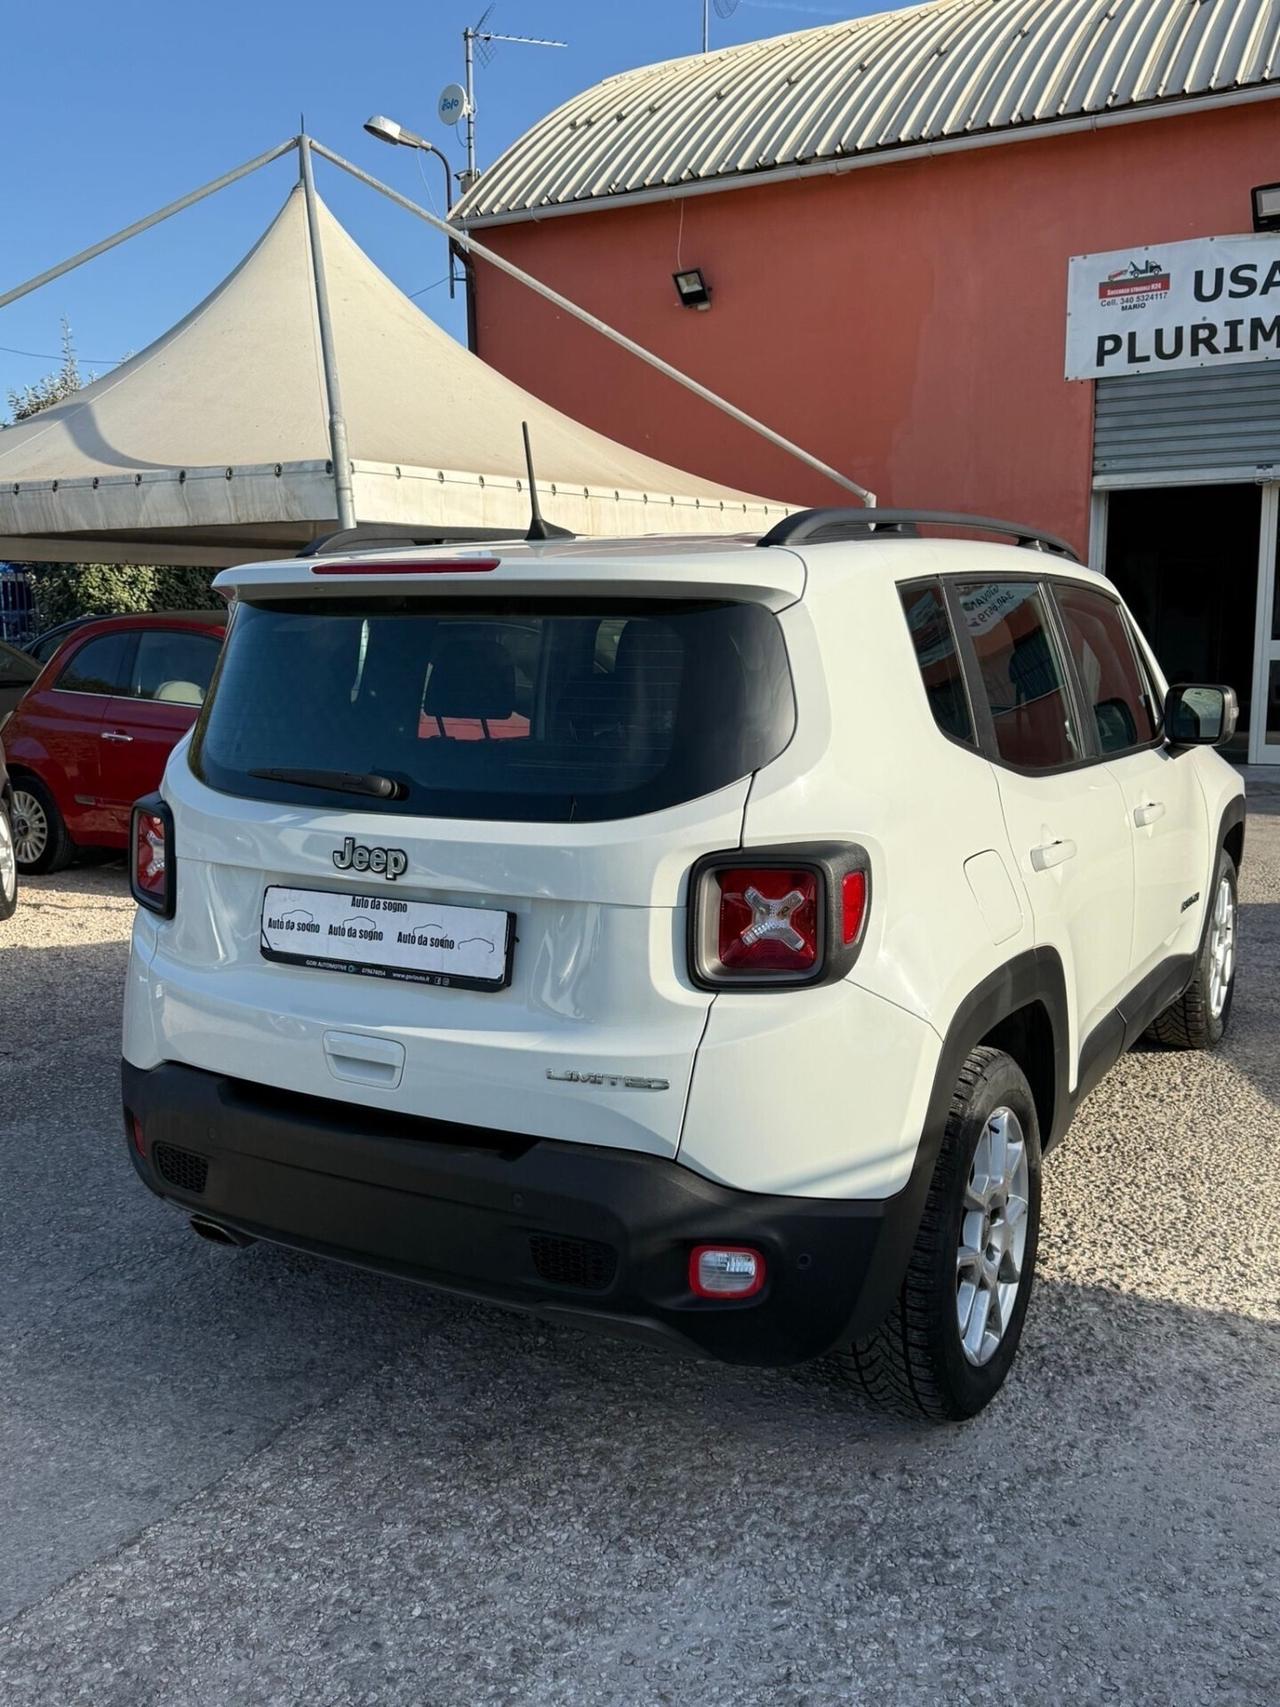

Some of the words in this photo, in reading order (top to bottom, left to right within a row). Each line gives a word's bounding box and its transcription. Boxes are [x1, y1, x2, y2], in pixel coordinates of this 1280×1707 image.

[1194, 260, 1280, 302] USA
[1120, 296, 1134, 305] 340
[1135, 292, 1168, 302] 5324117
[1121, 303, 1146, 311] MARIO
[1096, 315, 1280, 367] PLURIM
[333, 837, 408, 880] Jeep
[351, 896, 370, 909] Auto
[372, 898, 381, 910] da
[383, 900, 408, 913] sogno
[268, 917, 284, 930] Auto
[285, 918, 295, 931] da
[328, 925, 346, 937] Auto
[347, 927, 357, 939] da
[359, 930, 383, 942] sogno
[397, 932, 416, 945] Auto
[417, 934, 428, 947] da
[545, 1068, 670, 1091] LIMITED
